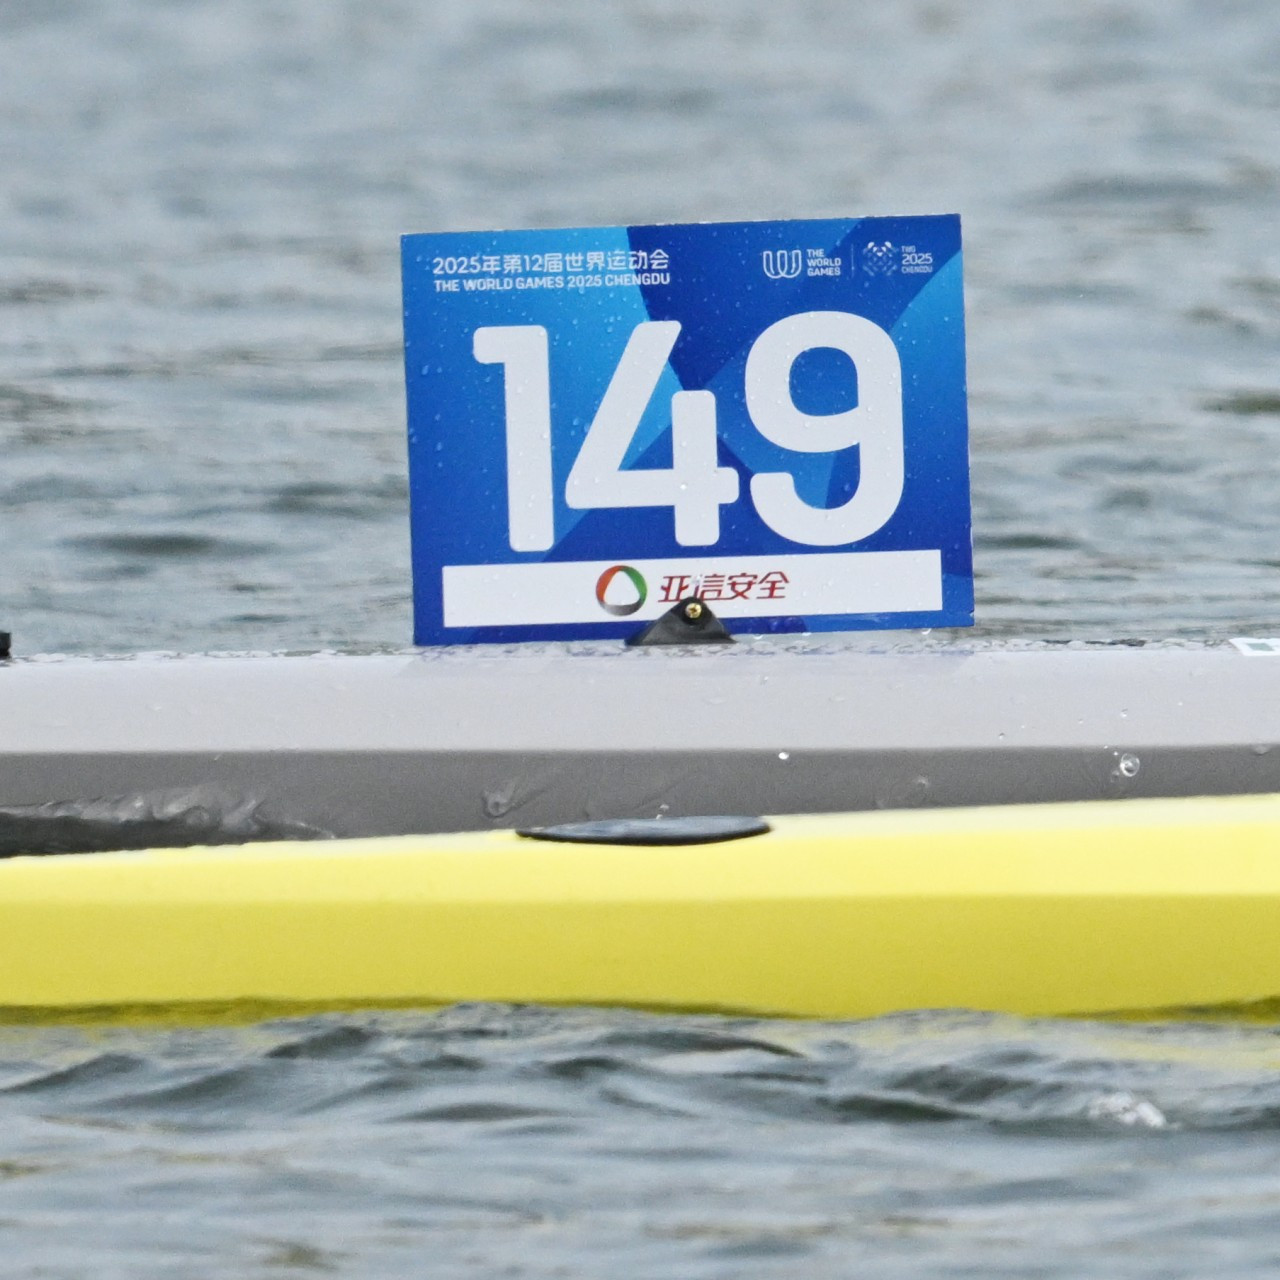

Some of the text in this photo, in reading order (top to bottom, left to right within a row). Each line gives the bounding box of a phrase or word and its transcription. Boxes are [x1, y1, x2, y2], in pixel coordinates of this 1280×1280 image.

[806, 248, 825, 258] THE
[901, 253, 933, 265] 2025
[432, 249, 670, 275] 2025年第12届世界运动会
[807, 258, 842, 267] WORLD
[807, 267, 841, 277] GAMES
[434, 273, 670, 292] THE WORLD GAMES 2025 CHENGDU
[473, 310, 905, 552] 149
[657, 570, 789, 604] 亚信安全
